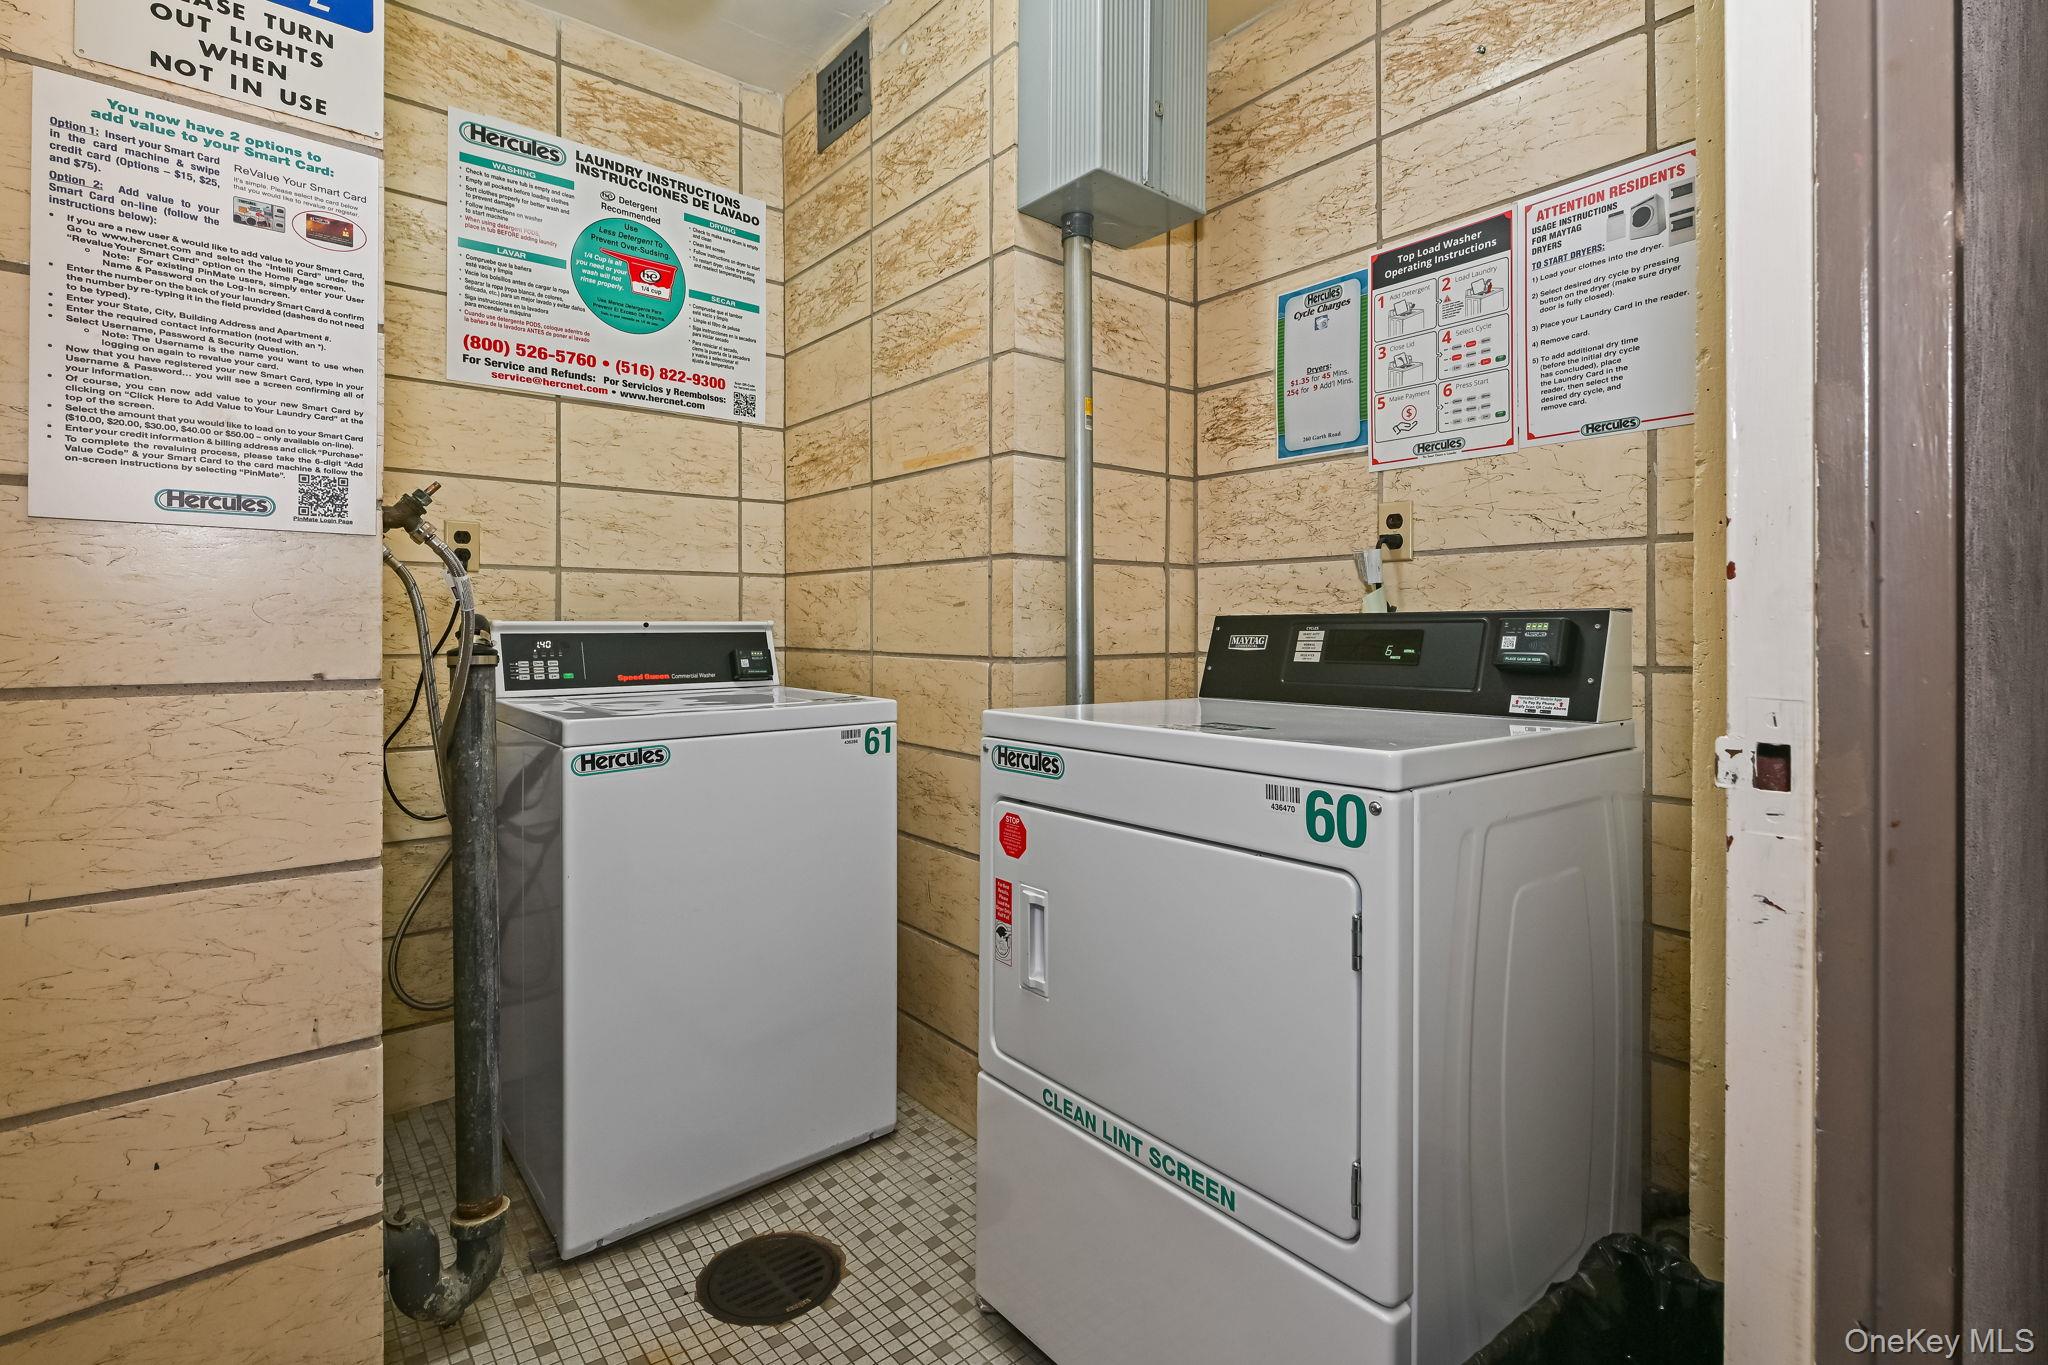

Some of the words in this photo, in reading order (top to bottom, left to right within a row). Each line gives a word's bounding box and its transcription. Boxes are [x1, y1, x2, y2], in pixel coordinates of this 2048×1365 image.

[150, 3, 211, 33] OUT
[230, 26, 323, 68] LIGHTS
[264, 12, 334, 49] TURN
[198, 39, 287, 80] WHEN
[150, 50, 213, 82] NOT
[231, 74, 262, 98] IN
[280, 89, 327, 116] USE
[49, 116, 86, 133] Option
[89, 126, 99, 136] 1:
[104, 129, 136, 144] Insert
[138, 139, 161, 150] your
[164, 144, 194, 158] Smart
[196, 152, 220, 164] Card
[106, 98, 139, 115] You
[144, 110, 180, 126] now
[185, 119, 224, 137] have
[229, 131, 240, 142] 2
[245, 137, 302, 157] options
[306, 151, 321, 162] to
[470, 121, 561, 163] Hercules
[49, 128, 60, 138] in
[67, 132, 86, 144] the
[92, 140, 117, 152] card
[124, 148, 169, 164] machine
[175, 158, 184, 167] &
[190, 163, 220, 176] swipe
[90, 109, 123, 124] add
[129, 119, 175, 137] value
[181, 130, 198, 142] to
[203, 138, 239, 152] your
[244, 146, 290, 166] Smart
[295, 159, 334, 177] Card:
[491, 161, 537, 179] WASHING
[575, 150, 642, 178] LAUNDRY
[647, 172, 740, 209] INSTRUCTIONS
[233, 164, 279, 182] ReValue
[282, 175, 307, 188] Your
[309, 182, 340, 197] Smart
[342, 190, 367, 203] Card
[575, 163, 688, 203] INSTRUCCIONES
[692, 197, 709, 211] DE
[713, 204, 759, 226] LAVADO
[1536, 190, 1604, 221] ATTENTION
[1609, 163, 1685, 197] RESIDENTS
[601, 201, 661, 224] Recommended
[618, 196, 657, 213] Detergent
[623, 222, 639, 234] Use
[708, 221, 737, 235] DRYING
[1531, 219, 1556, 234] USAGE
[1557, 201, 1618, 226] INSTRUCTIONS
[598, 225, 616, 236] Less
[618, 231, 653, 245] Detergent
[654, 240, 663, 248] To
[1531, 233, 1547, 245] FOR
[1547, 223, 1583, 239] MAYTAG
[496, 247, 528, 260] LAVAR
[590, 233, 619, 246] Prevent
[619, 240, 668, 260] Over-Sudsing.
[1384, 258, 1432, 278] Operating
[1434, 238, 1496, 263] Instructions
[1397, 252, 1415, 263] Top
[1417, 242, 1441, 257] Load
[1442, 231, 1482, 248] Washer
[1530, 239, 1563, 256] DRYERS
[1530, 258, 1543, 270] TO
[1541, 251, 1570, 267] START
[1568, 241, 1606, 259] DRYERS:
[1539, 270, 1558, 281] Load
[1559, 266, 1576, 277] your
[1578, 258, 1606, 270] clothes
[1607, 253, 1623, 262] into
[1624, 249, 1638, 257] the
[1639, 242, 1664, 253] dryer.
[1441, 277, 1451, 291] 2
[1454, 272, 1470, 283] Load
[1469, 266, 1497, 278] Laundry
[650, 288, 662, 296] cup
[709, 294, 737, 307] SECAR
[1307, 286, 1341, 305] Hercules
[1377, 295, 1384, 308] 1
[1388, 292, 1400, 302] Add
[1400, 283, 1430, 298] Detergent
[1293, 308, 1315, 321] Cycle
[1315, 298, 1350, 313] Charges
[1441, 330, 1451, 343] 4
[1455, 327, 1475, 336] Select
[1474, 323, 1492, 332] Cycle
[1531, 340, 1539, 348] 4)
[1540, 335, 1570, 345] Remove
[1571, 329, 1589, 339] card.
[463, 334, 510, 356] (800)
[516, 343, 596, 367] 526-5760
[615, 360, 654, 380] (516)
[659, 367, 725, 389] 822-9300
[1377, 346, 1386, 359] 3
[1389, 343, 1406, 352] Close
[1406, 340, 1415, 348] Lid
[462, 353, 481, 364] For
[484, 357, 524, 371] Service
[527, 365, 547, 375] and
[550, 367, 595, 382] Refunds:
[603, 376, 619, 386] Por
[622, 379, 663, 393] Servicios
[665, 387, 671, 396] y
[673, 387, 726, 403] Reembolsos:
[1290, 375, 1310, 387] $1.35
[1321, 371, 1331, 379] 45
[1332, 369, 1348, 377] Mins.
[1305, 362, 1333, 375] Dryers:
[491, 372, 608, 394] service@hercnet.com
[620, 391, 705, 409] www.hercnet.com
[1312, 383, 1320, 391] 9
[1336, 377, 1353, 385] Mins.
[1441, 382, 1453, 398] 6
[1455, 380, 1473, 389] Press
[1472, 378, 1489, 386] Start
[1376, 396, 1386, 410] 5
[1388, 393, 1406, 402] Make
[1405, 388, 1431, 399] Payment
[1586, 417, 1637, 433] Hercules
[1417, 438, 1463, 453] Hercules
[167, 489, 269, 514] Hercules
[1231, 636, 1265, 645] MAYTAG
[1384, 645, 1394, 656] 6
[617, 674, 644, 682] Speed
[865, 726, 891, 754] 61
[581, 747, 665, 771] Hercules
[997, 745, 1060, 774] Hercules
[1005, 815, 1020, 824] STOP
[1270, 803, 1296, 813] 436470
[1306, 789, 1367, 848] 60
[1042, 1088, 1097, 1133] CLEAN
[1102, 1119, 1143, 1157] LINT
[1149, 1147, 1236, 1212] SCREEN
